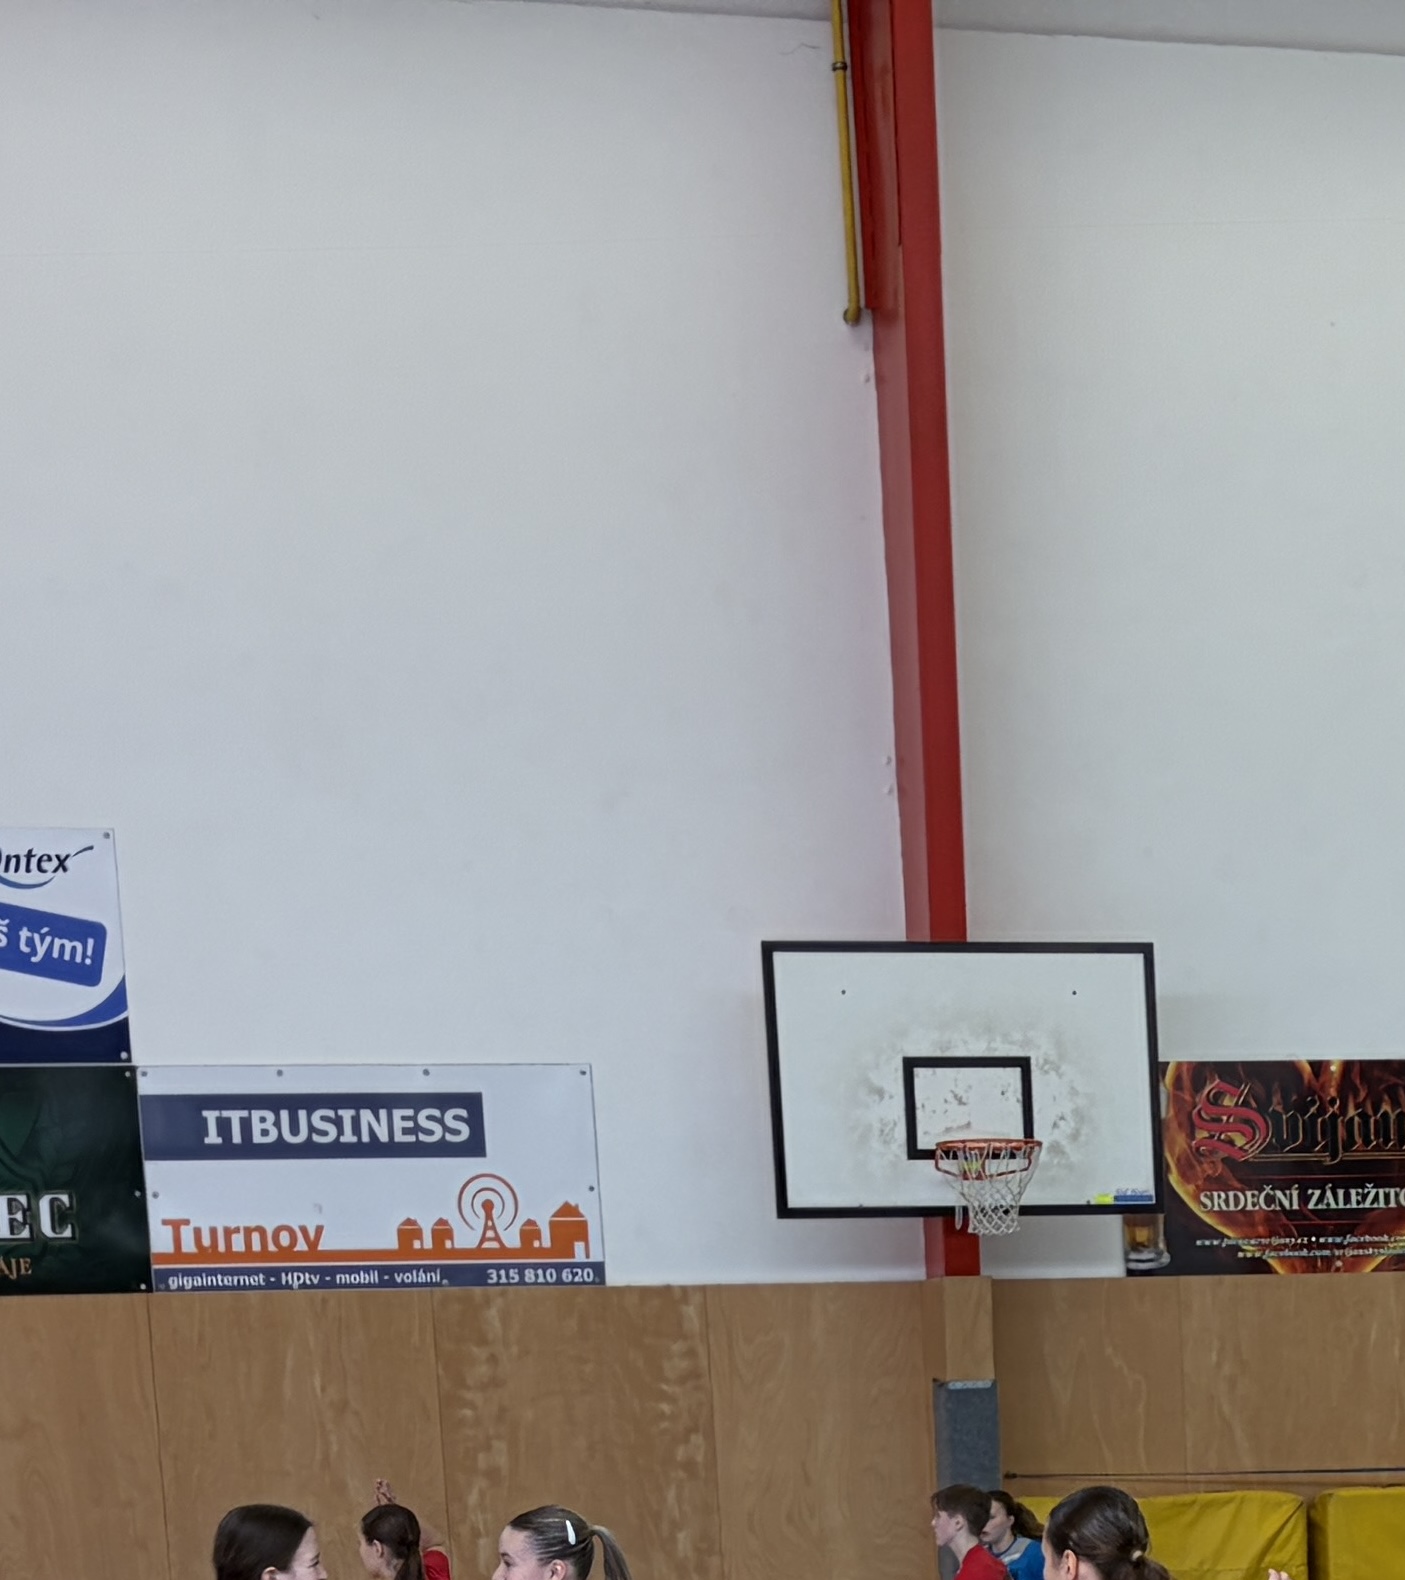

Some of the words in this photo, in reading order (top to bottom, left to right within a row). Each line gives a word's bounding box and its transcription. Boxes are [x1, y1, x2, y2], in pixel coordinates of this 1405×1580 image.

[0, 848, 71, 874] ntex
[19, 926, 95, 966] tým!
[201, 1106, 471, 1145] ITBUSINESS
[1199, 1184, 1300, 1212] SRDEČNÍ
[161, 1218, 325, 1253] Turnov
[335, 1270, 379, 1285] mobil
[486, 1268, 520, 1284] 315
[524, 1268, 557, 1284] 810
[561, 1267, 594, 1283] 620
